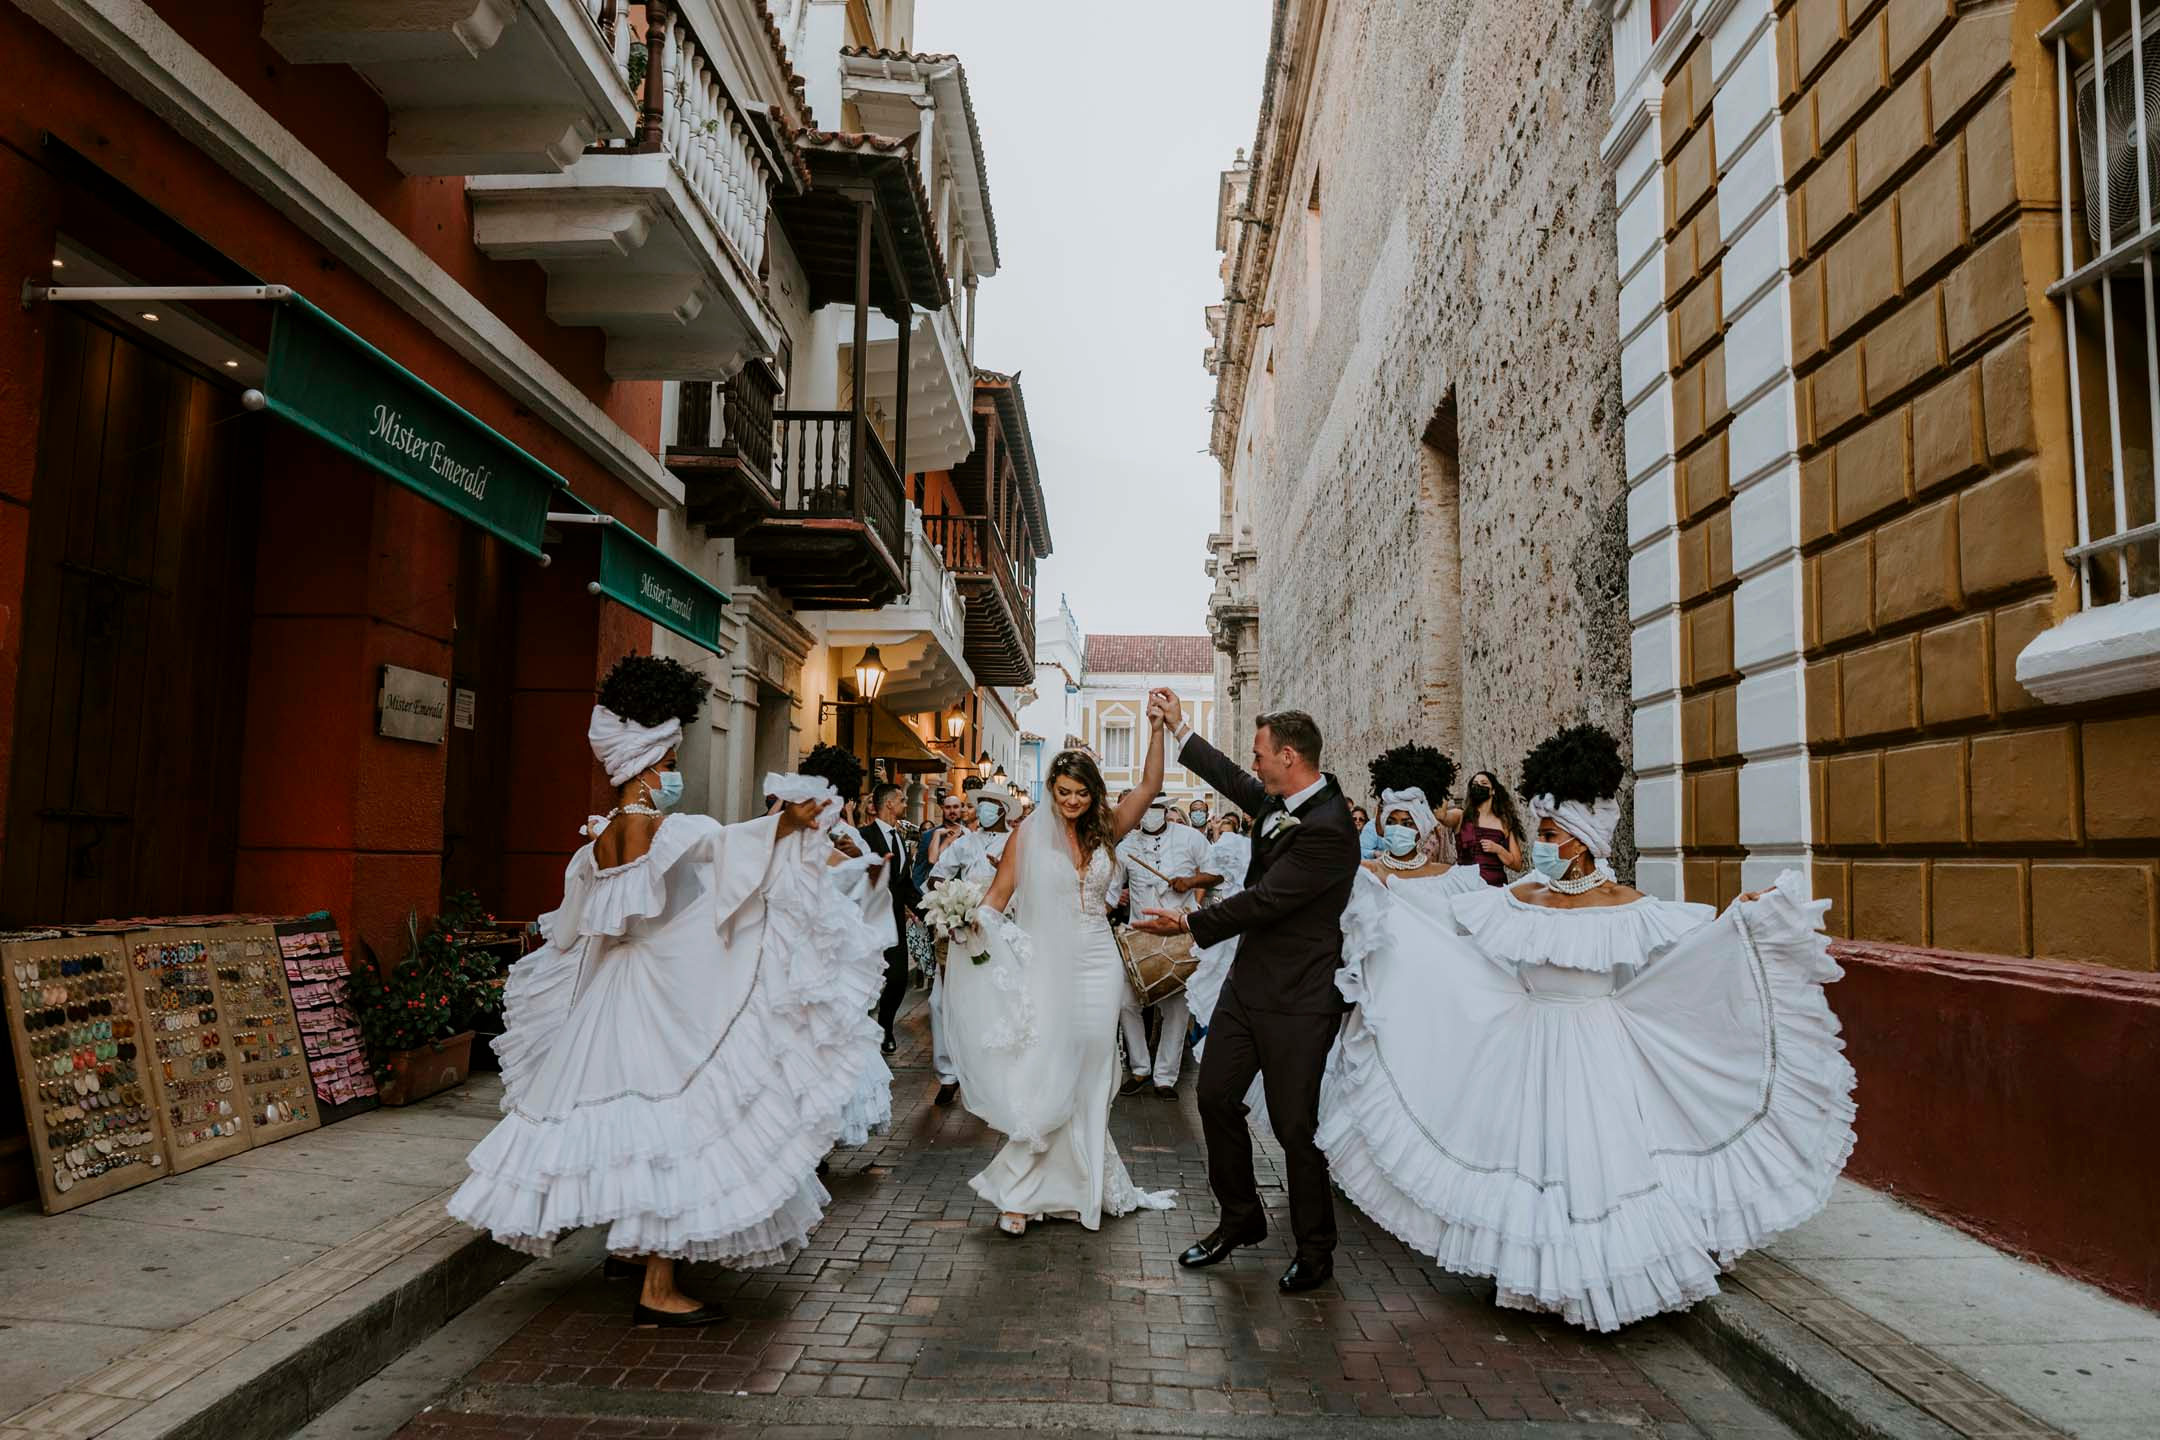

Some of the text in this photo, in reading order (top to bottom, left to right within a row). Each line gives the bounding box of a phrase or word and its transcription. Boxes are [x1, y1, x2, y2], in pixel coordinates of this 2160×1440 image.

[369, 404, 492, 501] Mister Emerald
[640, 573, 695, 621] Mister Emerald
[385, 693, 413, 713] Mister
[413, 699, 445, 719] Emerald
